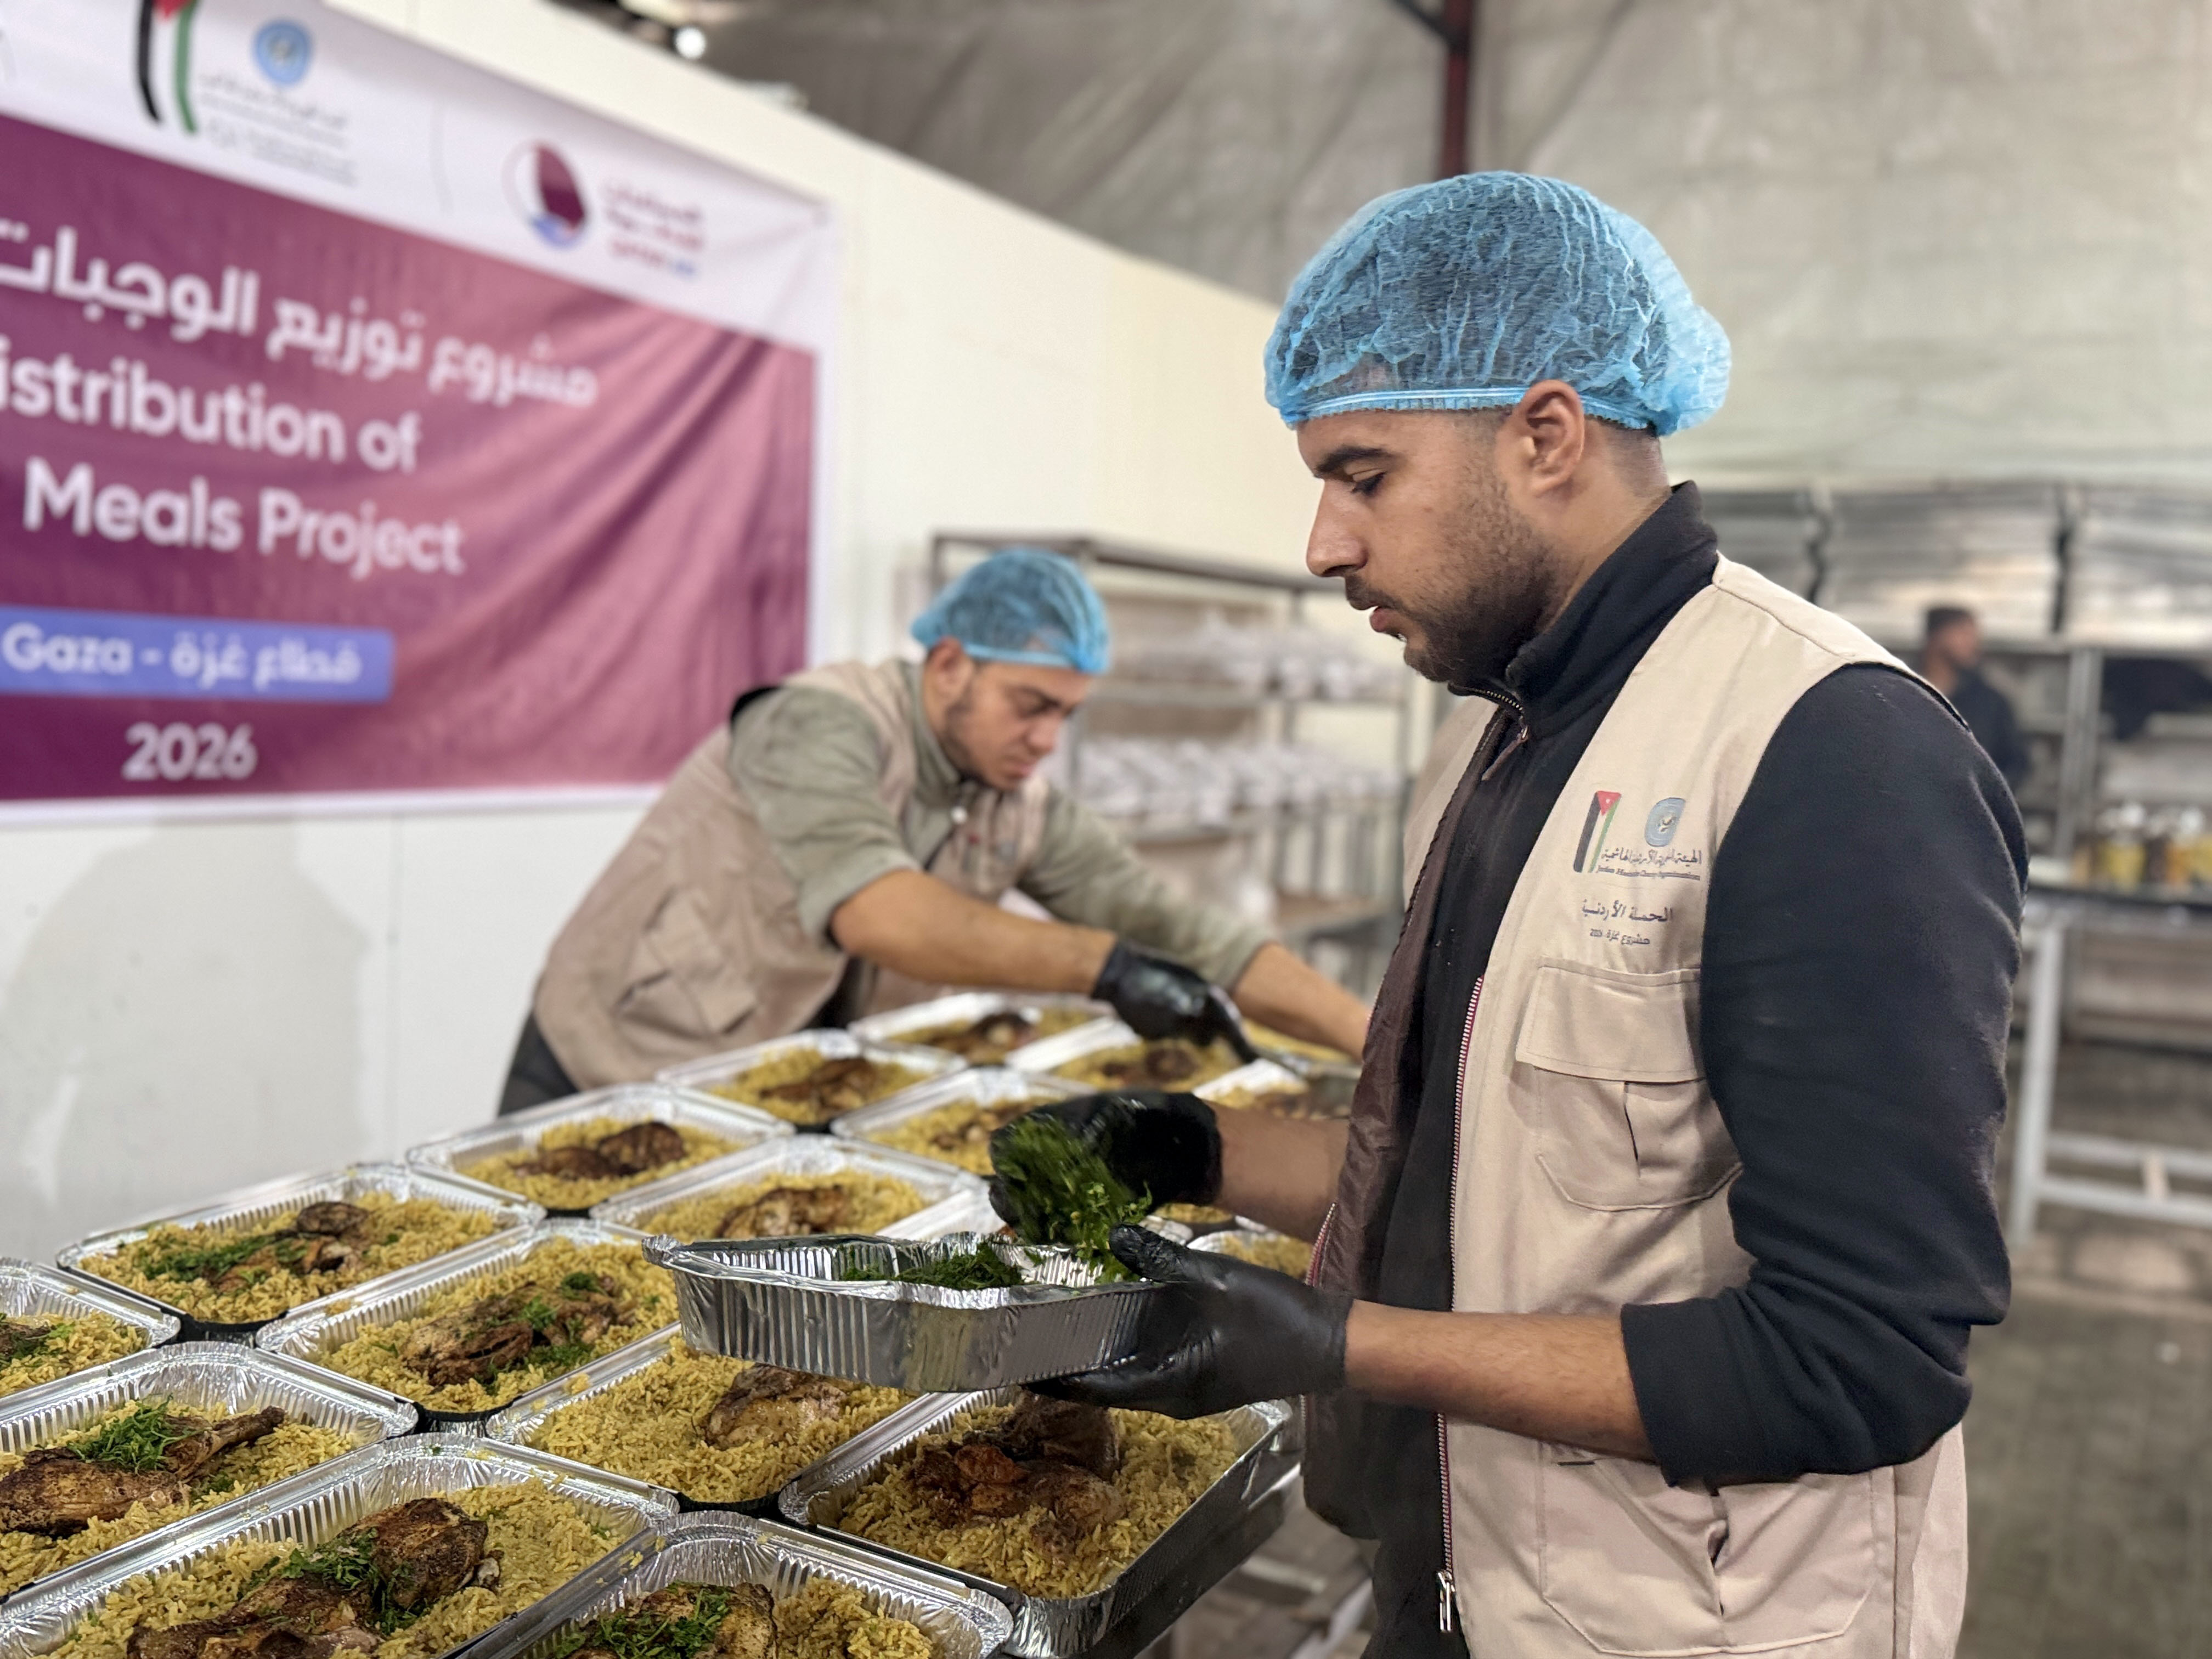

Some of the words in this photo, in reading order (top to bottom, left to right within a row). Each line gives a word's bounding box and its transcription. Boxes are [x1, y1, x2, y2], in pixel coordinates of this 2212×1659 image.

[265, 296, 426, 382] توزيع
[427, 332, 599, 408] مشروع
[355, 410, 422, 474] of
[23, 455, 244, 552] Meals
[256, 487, 465, 581] Project
[1, 621, 134, 674] Gaza
[169, 629, 248, 690] غزة
[252, 632, 363, 693] قطاع
[121, 721, 258, 781] 2026
